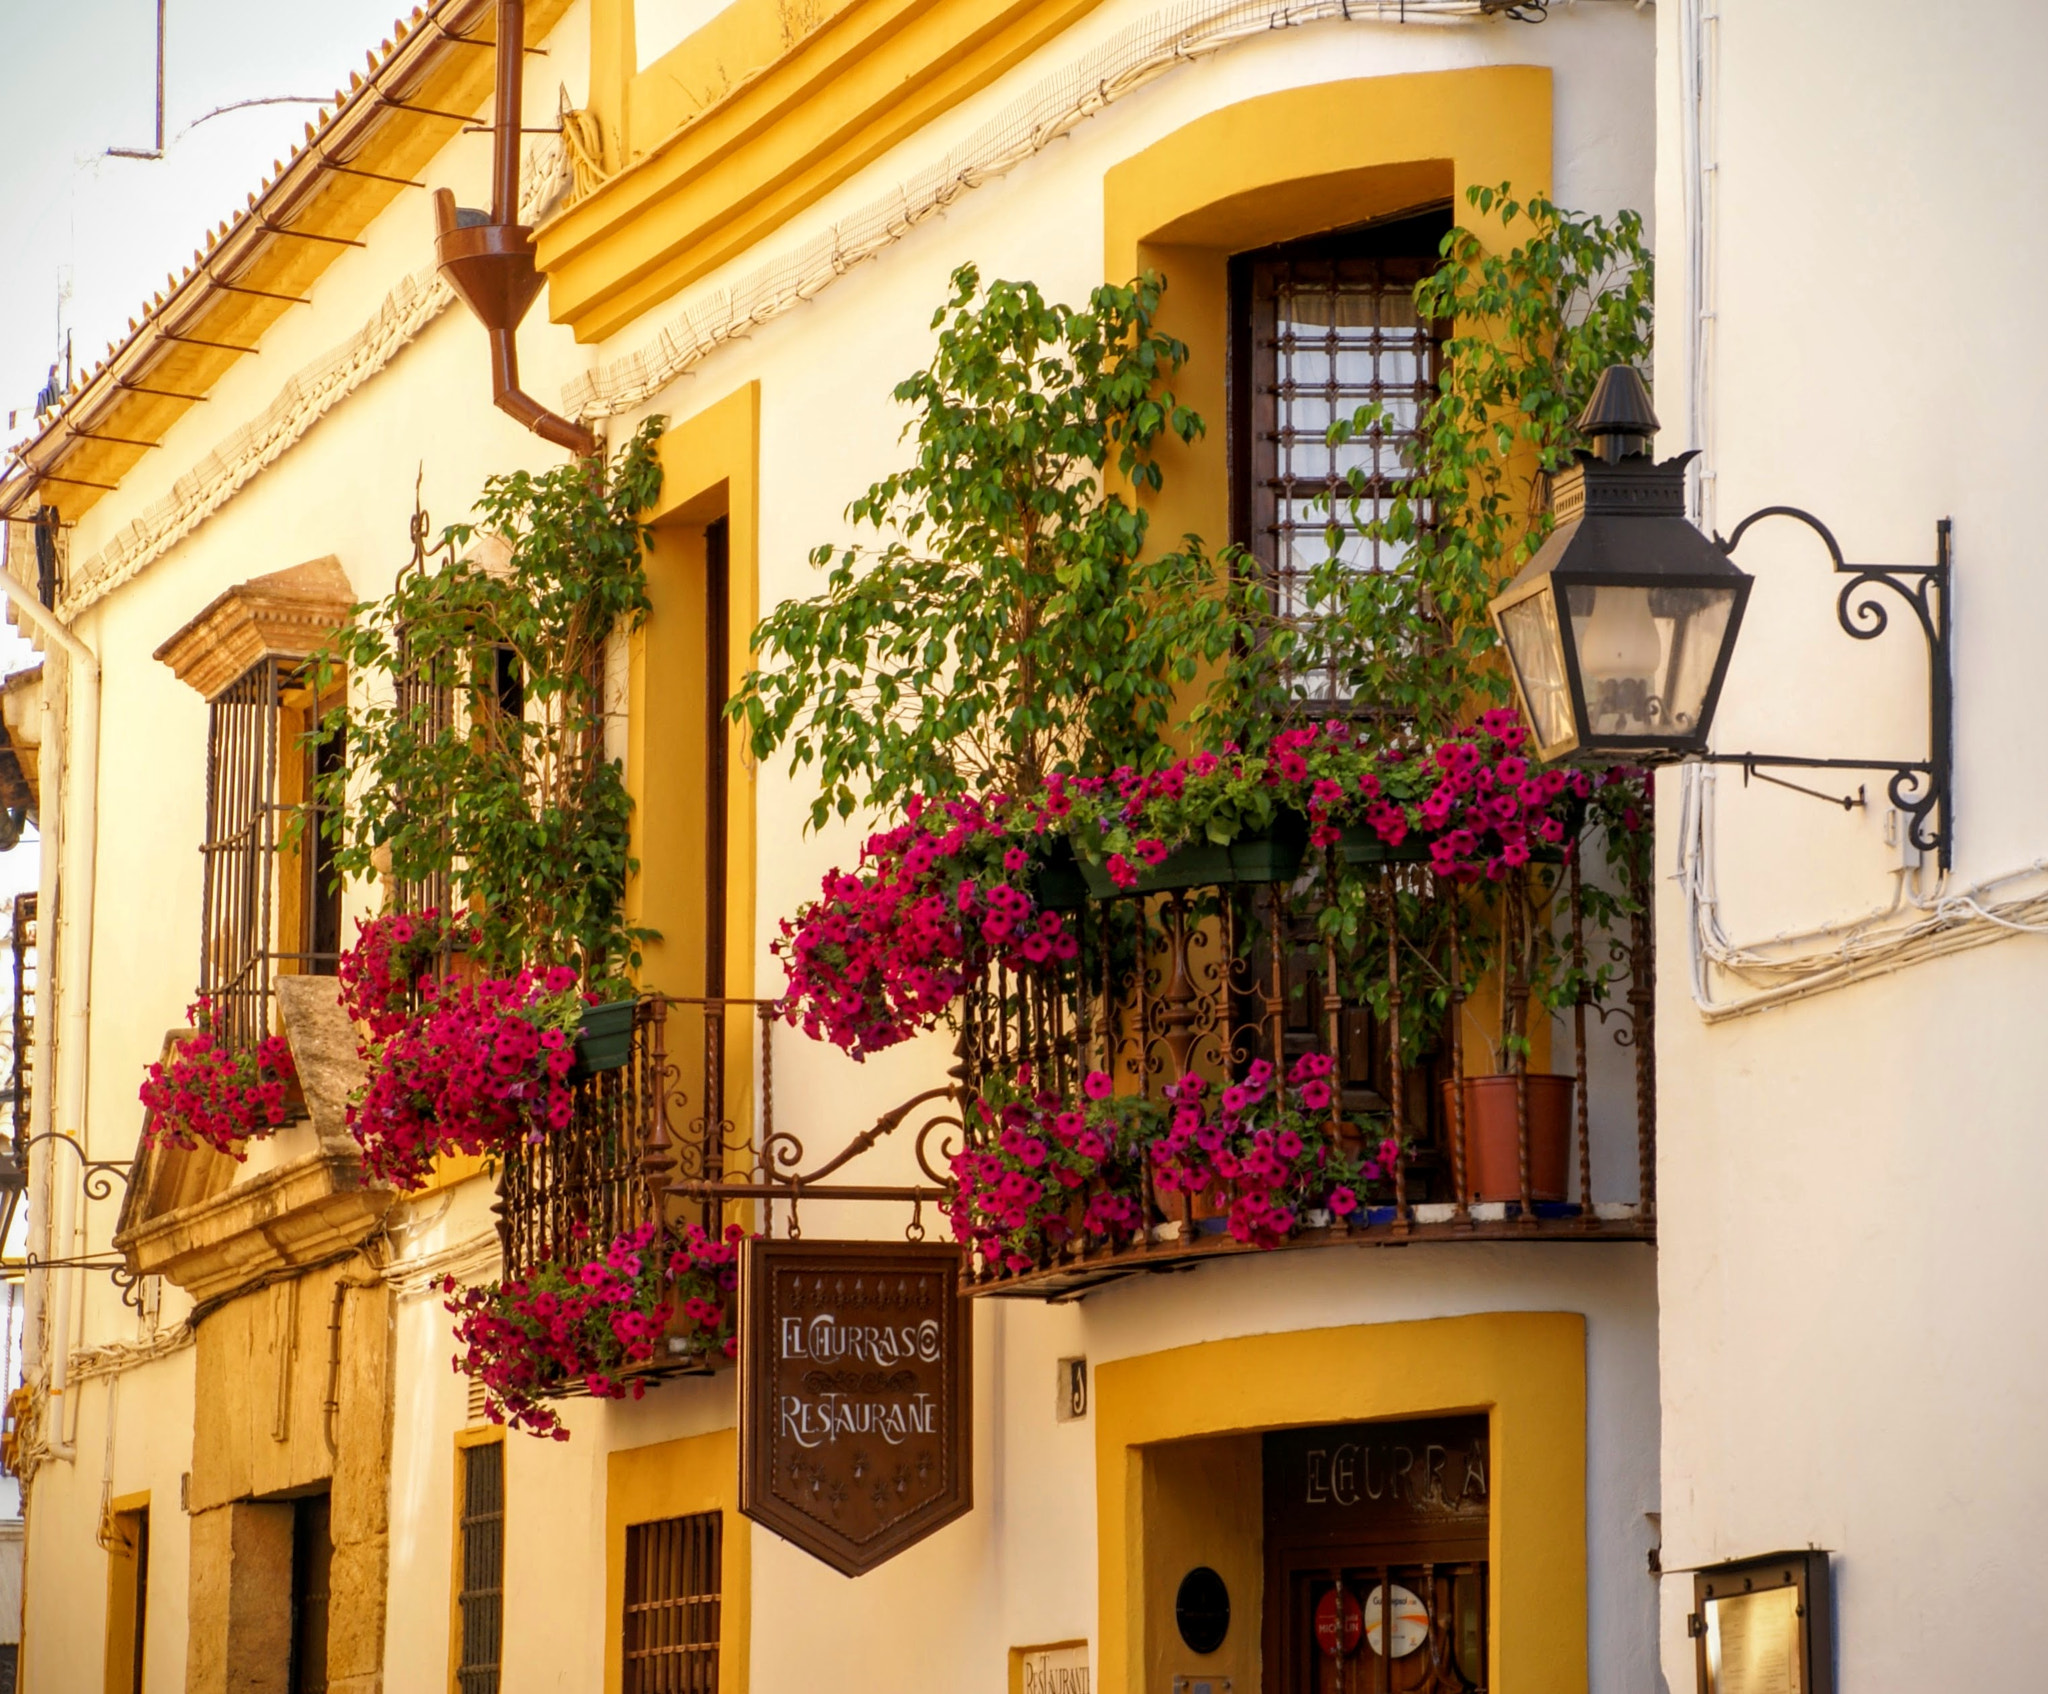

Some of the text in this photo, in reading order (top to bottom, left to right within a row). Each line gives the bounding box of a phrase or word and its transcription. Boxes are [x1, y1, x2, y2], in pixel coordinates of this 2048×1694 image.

[782, 1314, 940, 1366] EL CHURRASCO
[781, 1393, 937, 1448] RESTAURANTE
[1318, 1623, 1359, 1634] MICLIN
